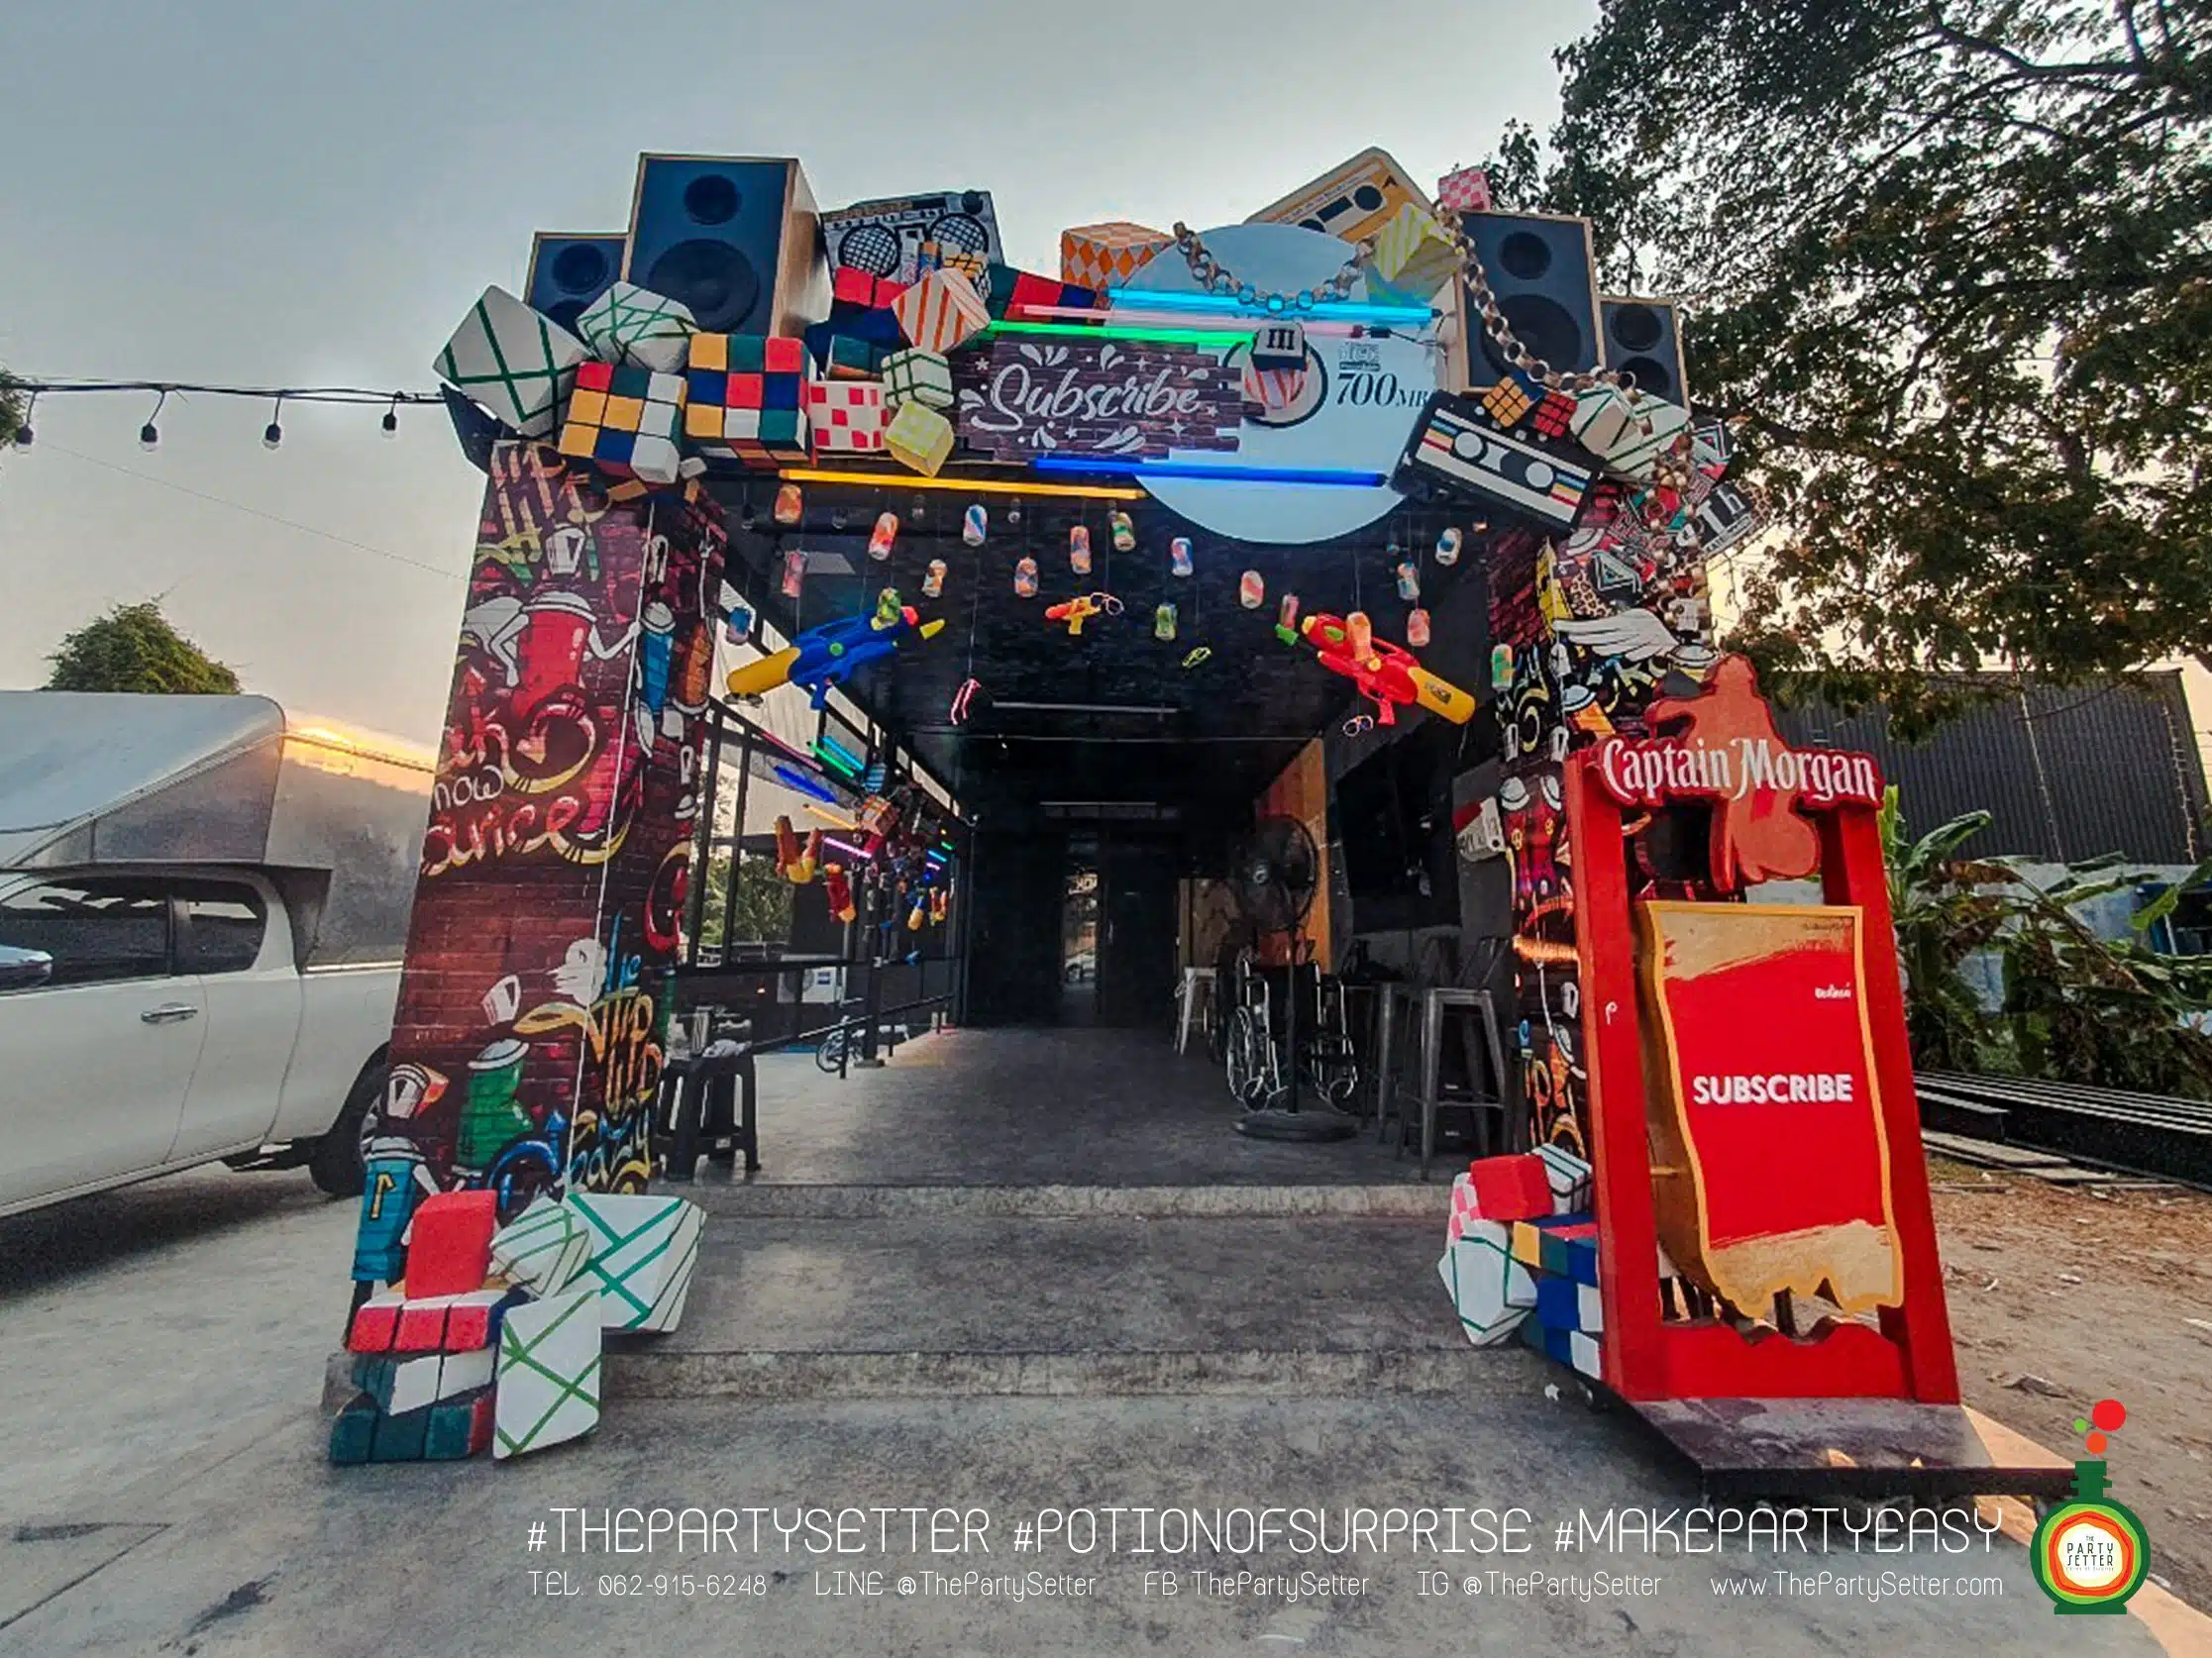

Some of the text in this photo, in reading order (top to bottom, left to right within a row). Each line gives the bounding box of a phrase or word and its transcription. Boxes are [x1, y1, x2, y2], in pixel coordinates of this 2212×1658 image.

[971, 363, 1202, 431] Subscribe
[1603, 737, 1877, 802] Captain Morgan
[1693, 1074, 1853, 1105] SUBSCRIBE
